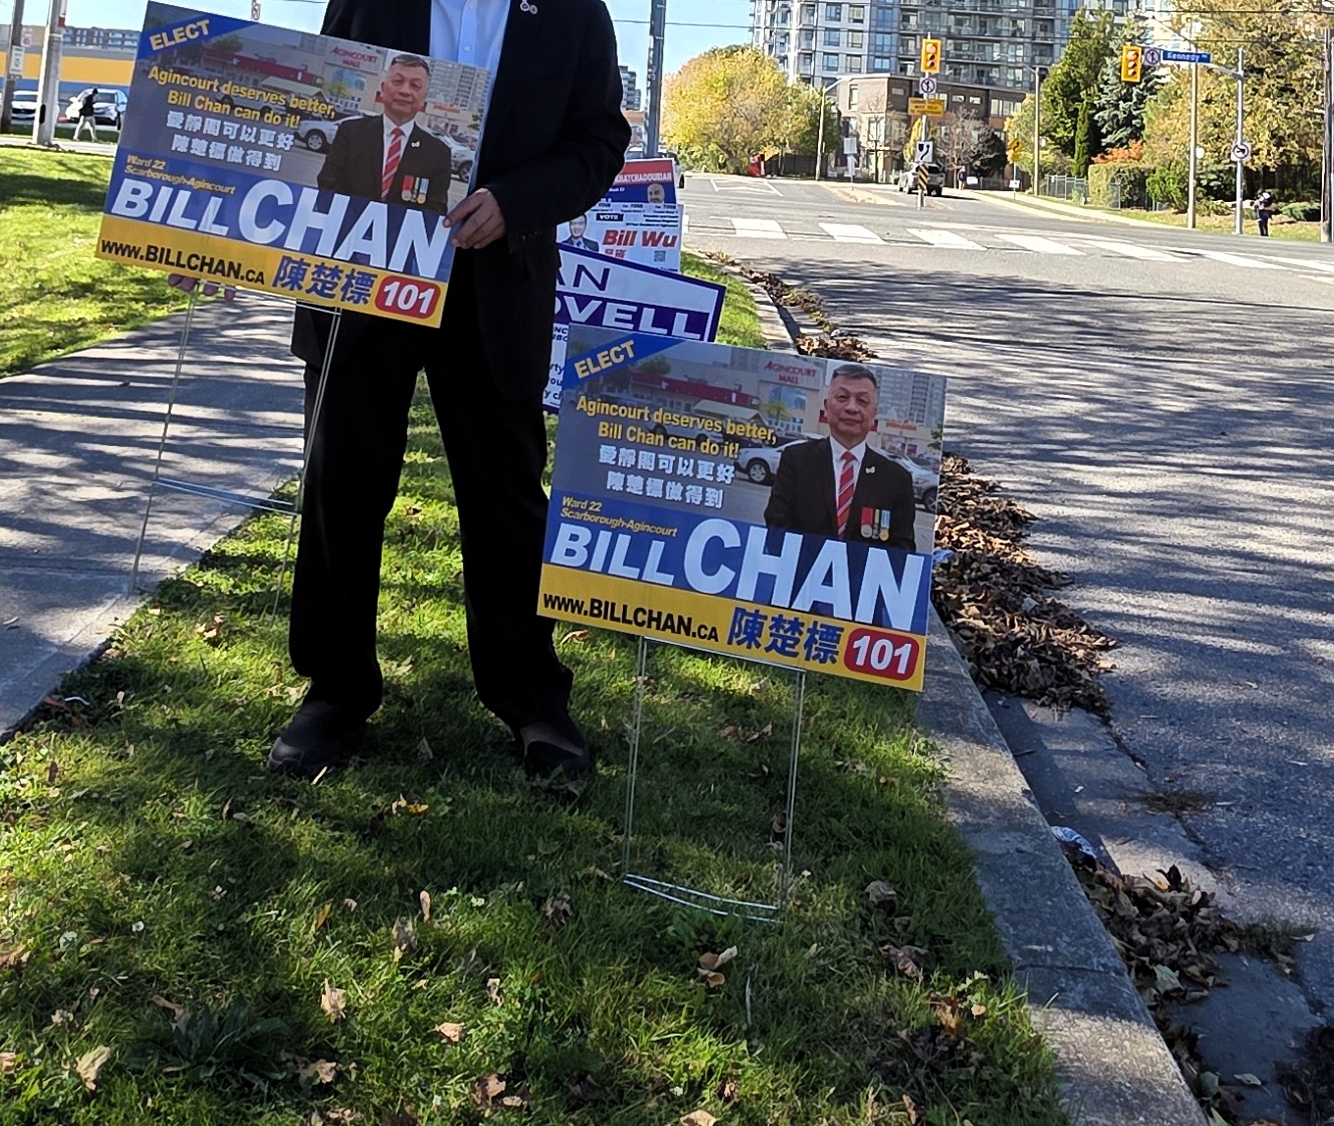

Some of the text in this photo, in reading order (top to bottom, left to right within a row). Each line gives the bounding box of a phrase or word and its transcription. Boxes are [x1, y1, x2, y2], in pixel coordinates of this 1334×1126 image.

[149, 19, 210, 51] ELECT
[1167, 52, 1201, 62] Kennedy
[147, 65, 336, 119] Agincourt deserves better,
[168, 89, 300, 129] Bill Chan can do it!
[124, 164, 236, 195] Scarborough-Agincourt
[127, 154, 166, 170] Ward 22
[111, 178, 451, 279] BILL CHAN
[602, 229, 678, 248] Bill Wu
[272, 255, 378, 305] 陳楚標
[383, 280, 435, 315] 101
[555, 296, 701, 339] VELL
[574, 340, 635, 379] ELECT
[764, 361, 817, 377] AGINCOURT
[778, 374, 799, 385] MALL
[576, 395, 777, 444] Agincourt deserves better,
[598, 421, 739, 459] Bill Chan can do it!
[560, 507, 678, 538] Scarborough-Agincourt
[562, 496, 602, 512] Ward 22
[550, 518, 925, 632] BILL CHAN
[727, 606, 845, 665] 陳楚標
[852, 635, 912, 675] 101
